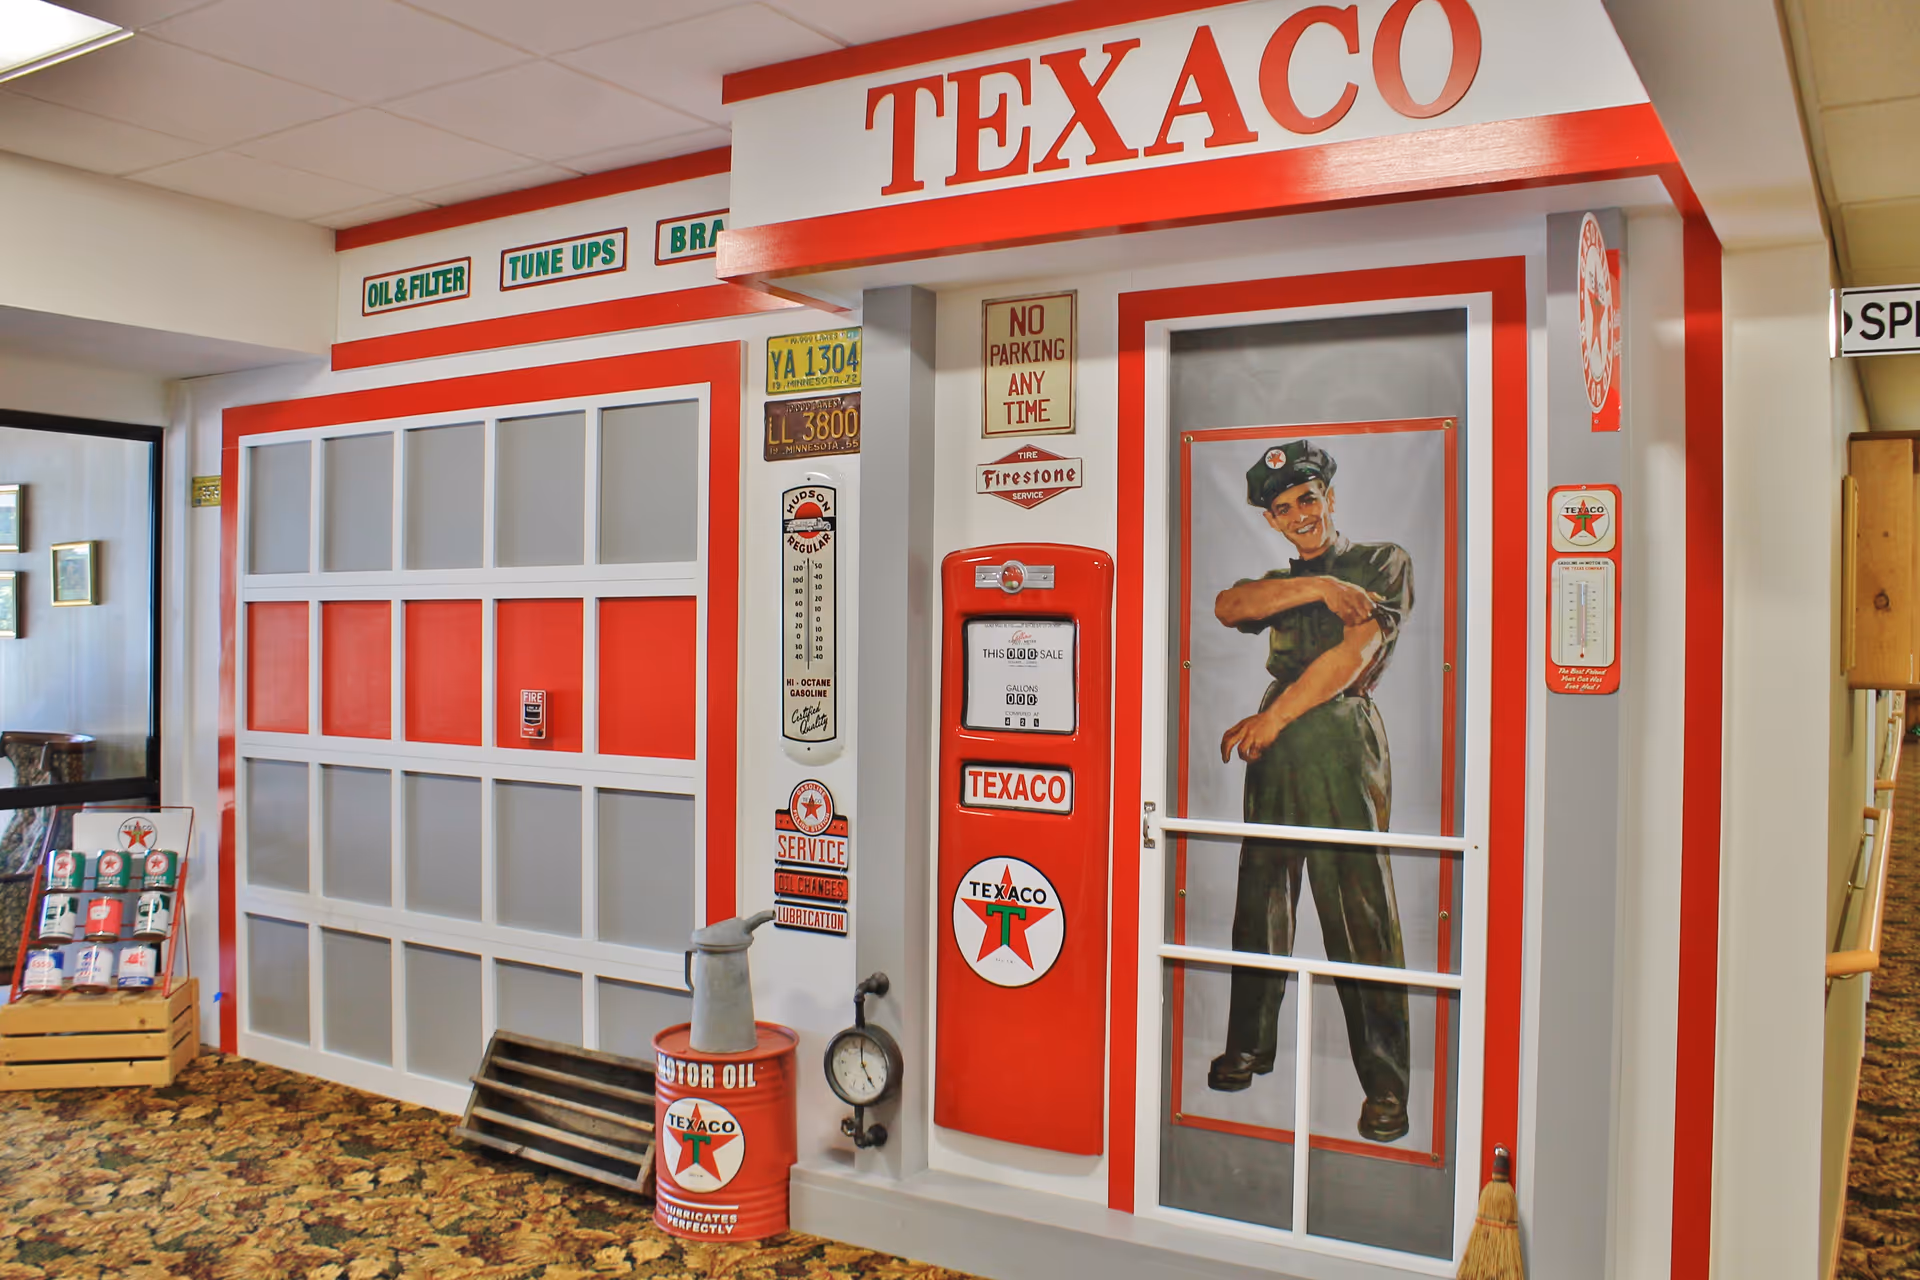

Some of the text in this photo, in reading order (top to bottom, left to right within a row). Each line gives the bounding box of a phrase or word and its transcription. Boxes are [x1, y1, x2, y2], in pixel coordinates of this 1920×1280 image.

[865, 0, 1482, 196] TEXACO
[509, 238, 616, 282] TUNE UPS
[1009, 304, 1045, 337] NO
[1859, 301, 1920, 340] SP
[771, 341, 859, 380] YA 1304
[990, 338, 1065, 367] PARKING
[1008, 371, 1046, 396] ANY
[1003, 399, 1051, 425] TIME
[768, 408, 858, 445] LL 3800
[1017, 451, 1038, 459] TIRE
[982, 468, 1076, 489] Firestone
[786, 490, 831, 514] HUDSON
[1012, 491, 1044, 500] SERVICE
[786, 532, 831, 554] REGULAR
[983, 648, 1005, 658] THIS
[1040, 649, 1064, 660] SALE
[786, 678, 794, 686] HI
[801, 678, 831, 687] OCTANE
[790, 689, 828, 698] GASOLINE
[1005, 684, 1039, 693] GALLONS
[523, 692, 543, 703] FIRE
[799, 713, 828, 735] Quality
[796, 784, 826, 797] GASOLINE
[968, 770, 1066, 804] TEXACO
[793, 809, 830, 832] FILLING STATION
[777, 835, 845, 865] SERVICE
[778, 874, 844, 898] OIL CHANGES
[969, 881, 1047, 904] TEXACO
[777, 906, 844, 930] LUBRICATION
[986, 904, 1026, 947] T
[657, 1052, 757, 1089] MOTOR OIL
[668, 1112, 735, 1133] TEXACO
[683, 1133, 711, 1165] T
[665, 1203, 738, 1224] LUBRICATES
[667, 1214, 734, 1235] PERFECTLY
